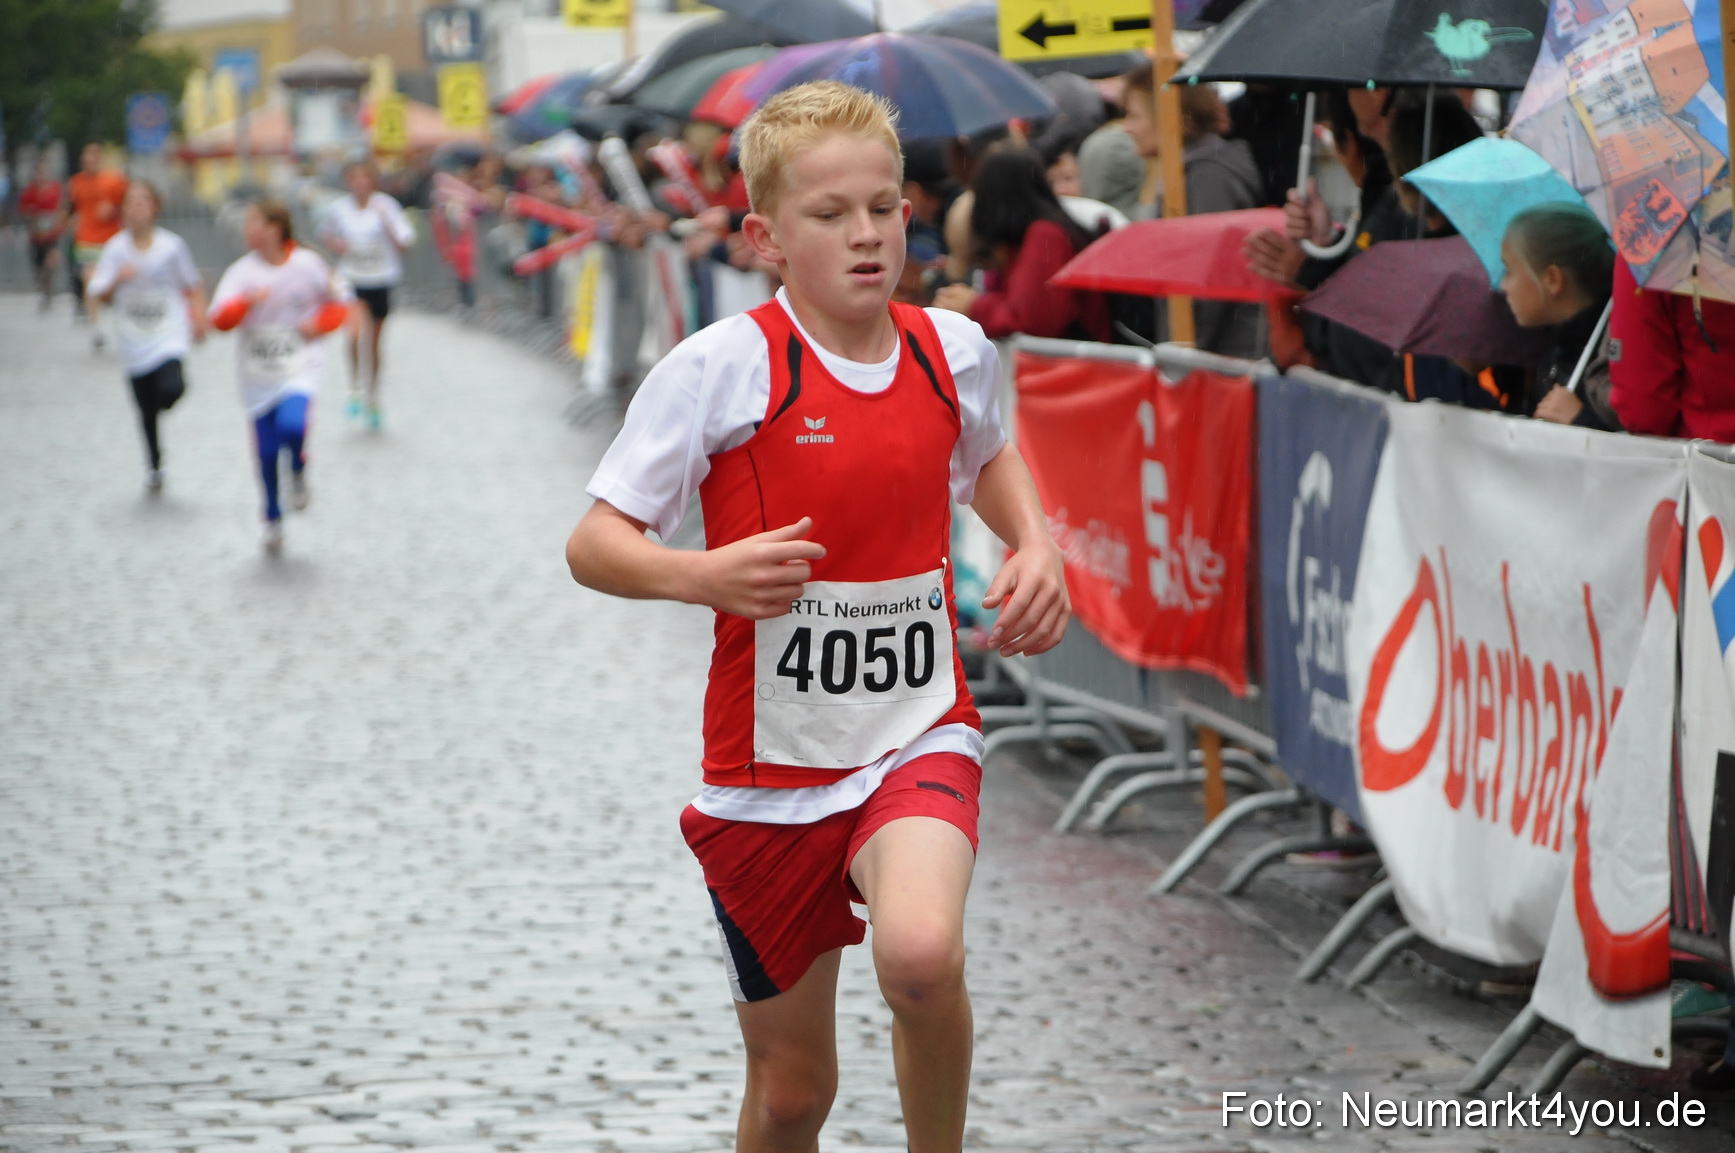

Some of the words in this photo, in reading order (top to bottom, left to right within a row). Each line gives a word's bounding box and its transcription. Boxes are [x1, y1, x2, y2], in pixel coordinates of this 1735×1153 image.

[795, 432, 834, 444] erima
[834, 596, 921, 618] Neumarkt
[776, 621, 935, 695] 4050
